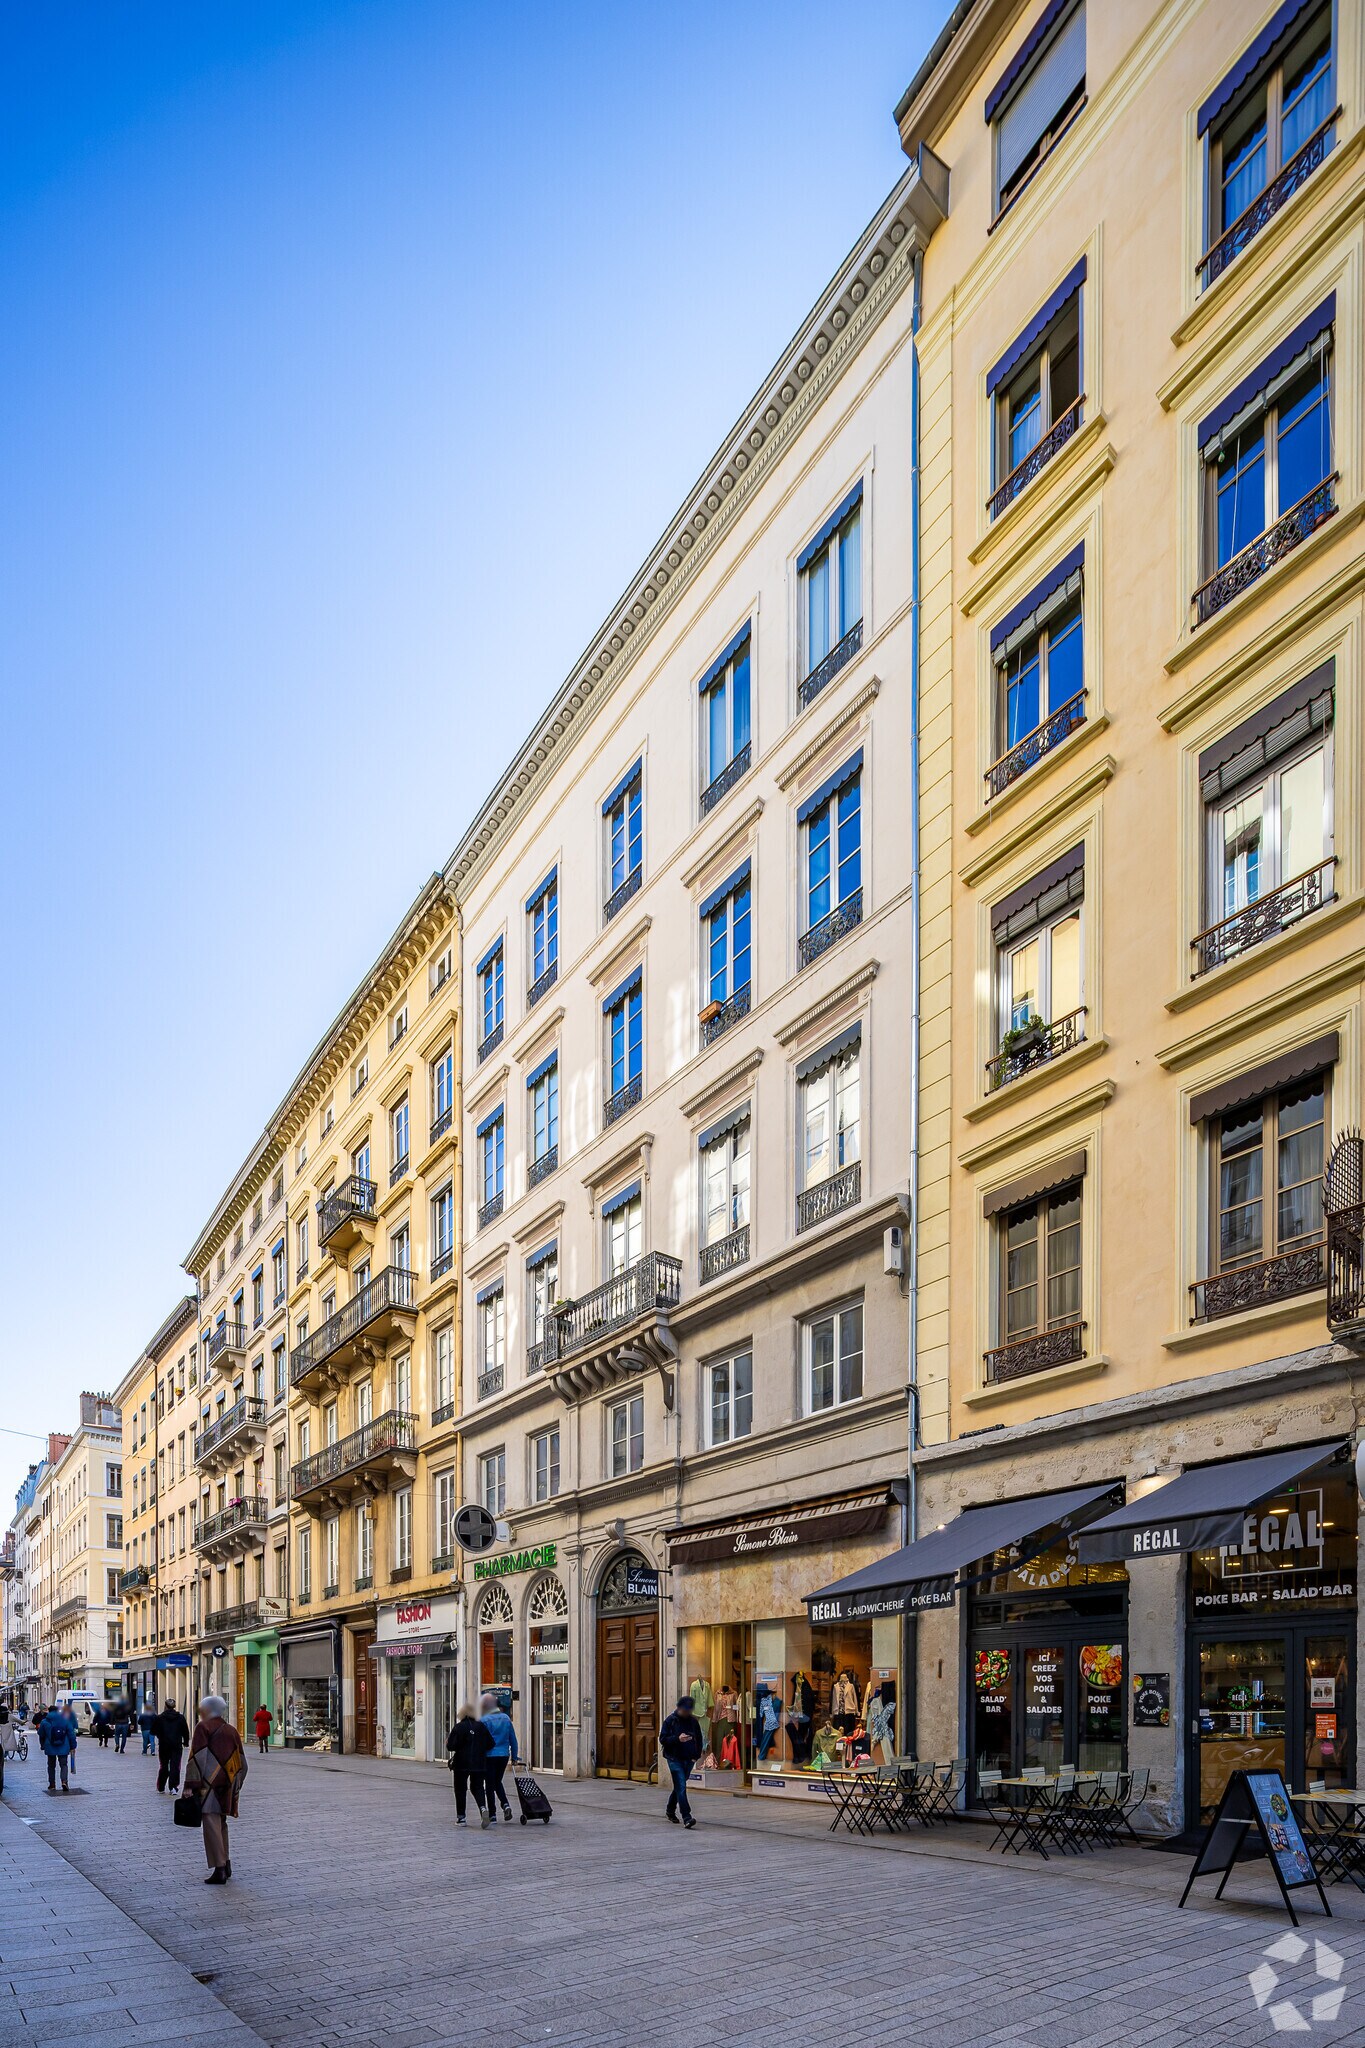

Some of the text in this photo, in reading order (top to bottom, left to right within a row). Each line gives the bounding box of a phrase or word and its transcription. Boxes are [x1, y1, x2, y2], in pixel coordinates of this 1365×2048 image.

[733, 1526, 798, 1553] Simone Blain
[1219, 1510, 1325, 1557] ÉGAL
[1133, 1528, 1181, 1552] RÉGAL
[474, 1543, 558, 1581] PHARMACIE
[627, 1569, 657, 1584] Simone
[627, 1583, 658, 1595] BLAIN
[1195, 1594, 1228, 1606] POKE
[1231, 1591, 1258, 1604] BAR
[812, 1591, 952, 1621] RÉGAL SANDWICHERIE POKE BAR
[396, 1602, 432, 1625] FASHION
[408, 1626, 421, 1634] STORE
[385, 1645, 423, 1657] FASHION STORE
[530, 1643, 569, 1656] PHARMACIE
[1038, 1654, 1050, 1662] ICI
[1035, 1675, 1053, 1683] VOS
[1033, 1685, 1055, 1693] POKE
[980, 1695, 1007, 1703] SALAD'
[1087, 1695, 1111, 1703] POKE
[1138, 1690, 1149, 1703] POKE
[985, 1705, 1002, 1713] BAR
[1026, 1706, 1063, 1714] SALADES
[1090, 1706, 1109, 1714] BAR
[1140, 1705, 1162, 1715] SALADES
